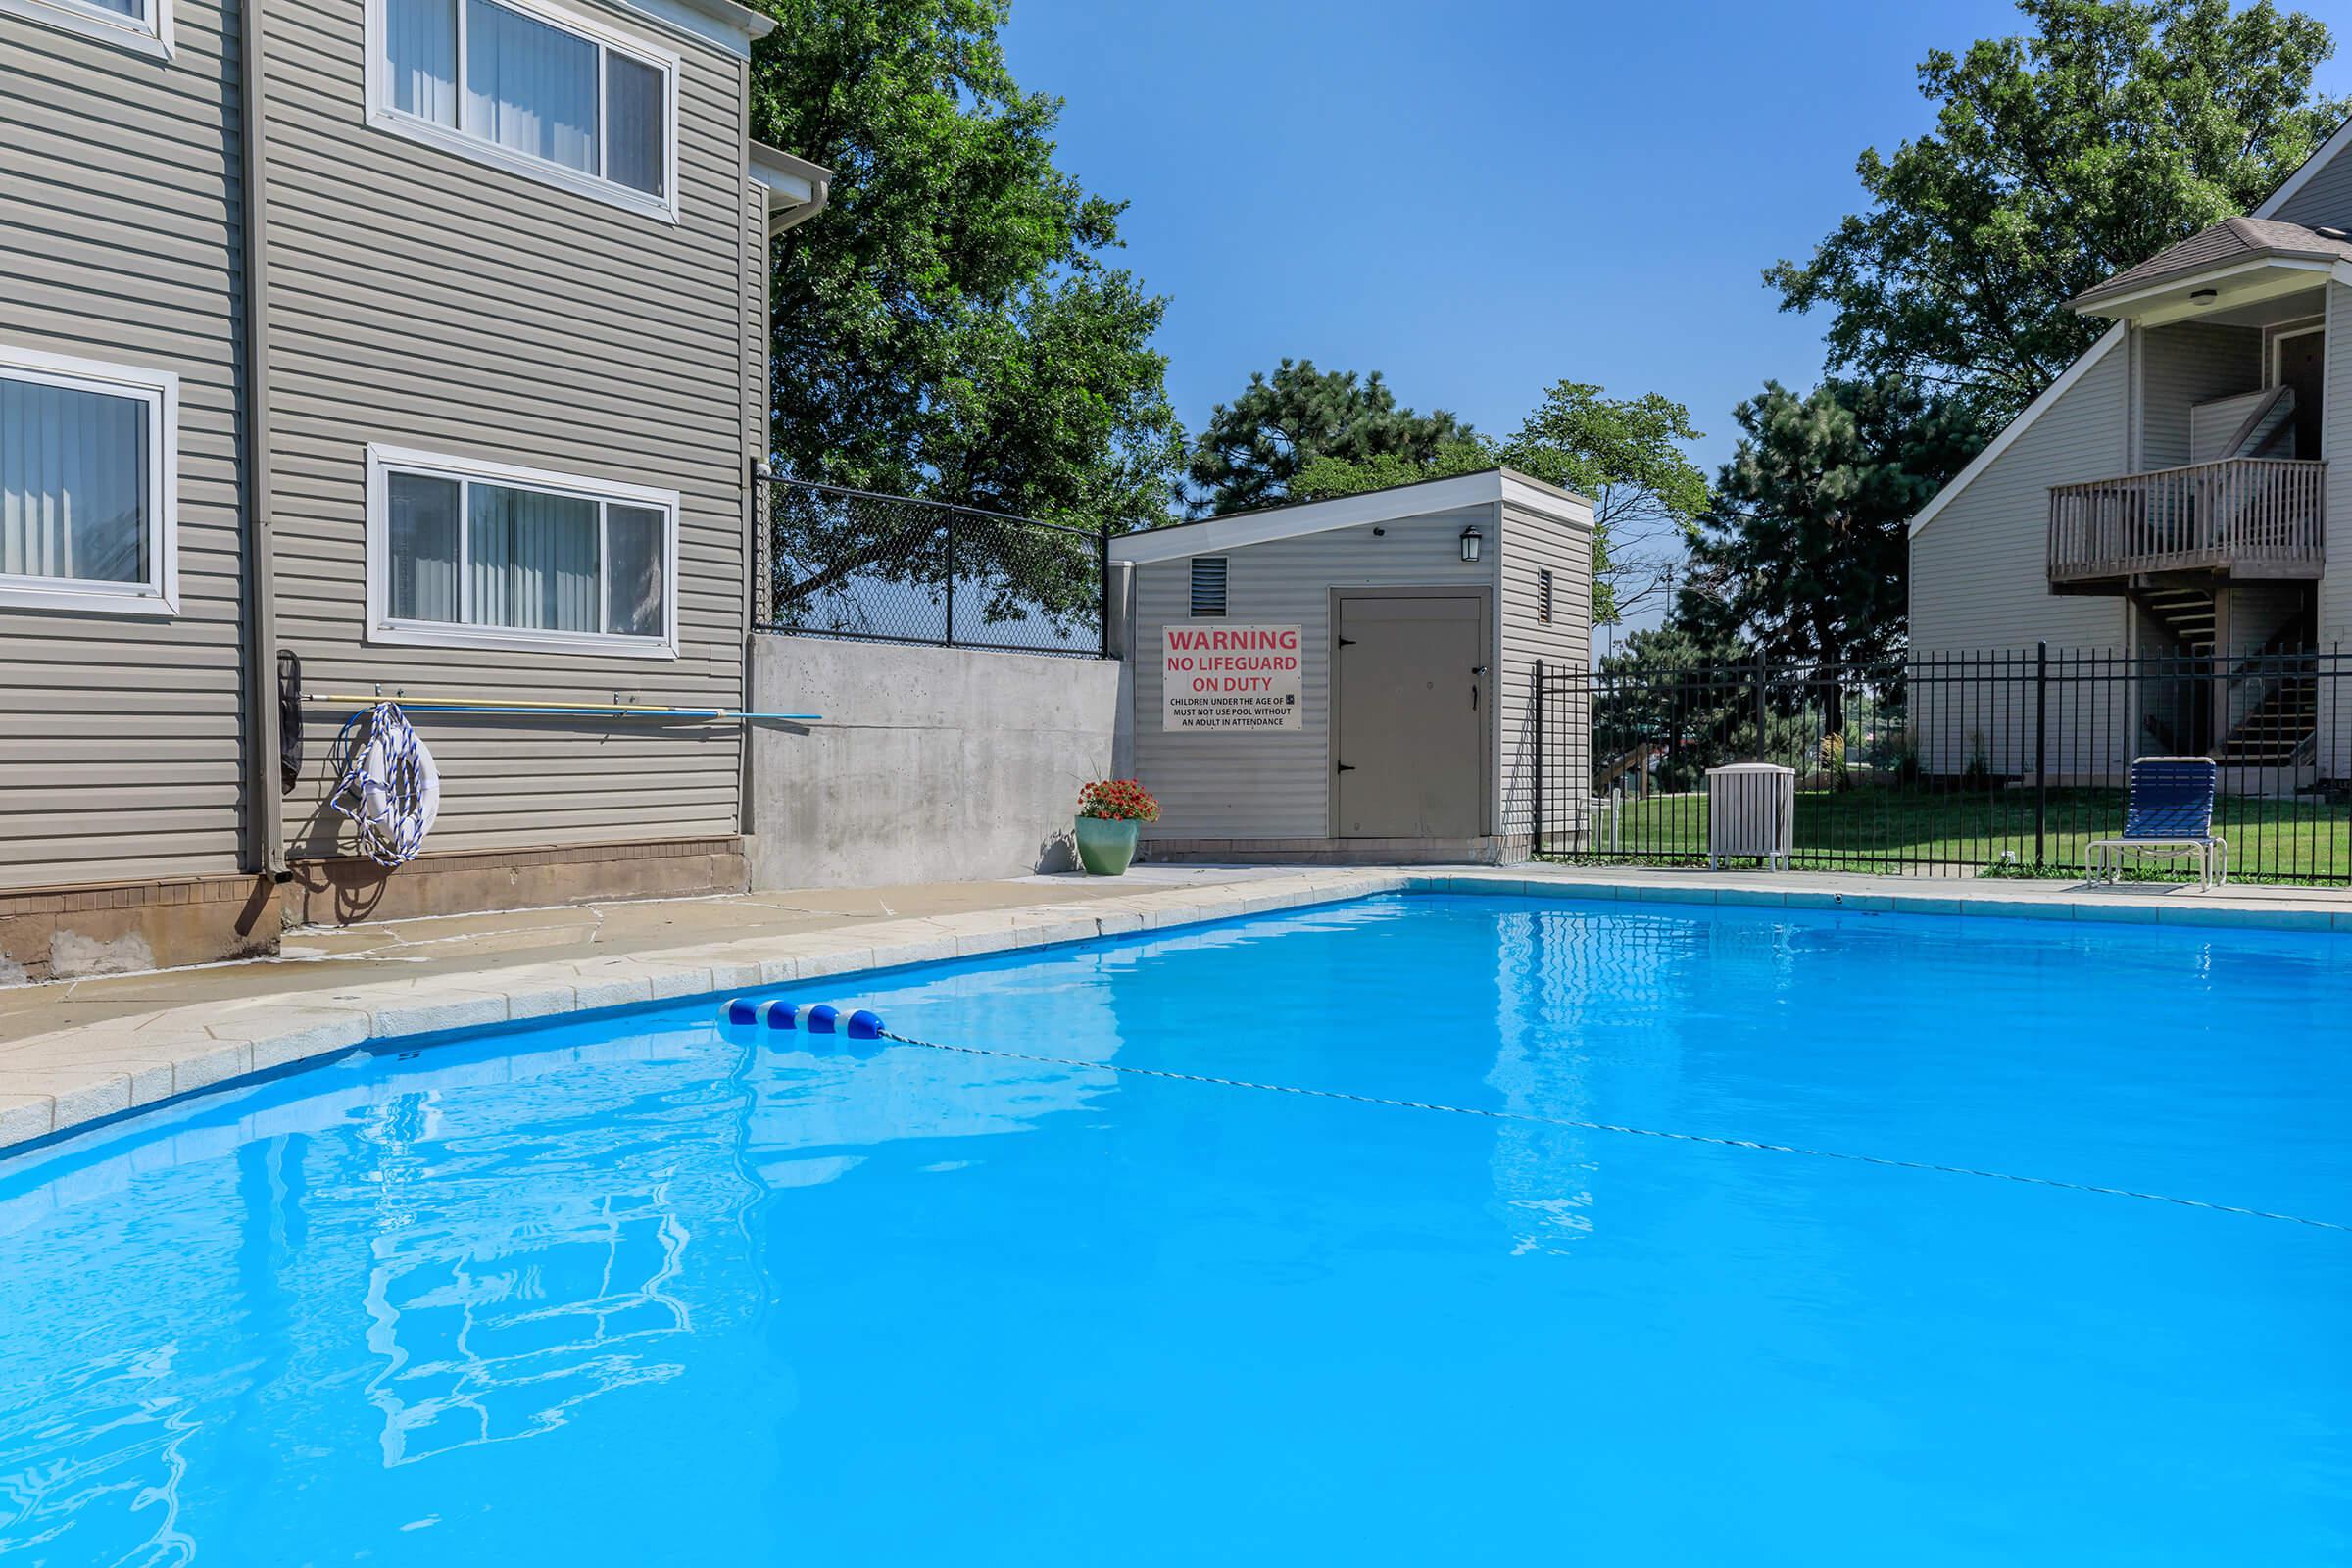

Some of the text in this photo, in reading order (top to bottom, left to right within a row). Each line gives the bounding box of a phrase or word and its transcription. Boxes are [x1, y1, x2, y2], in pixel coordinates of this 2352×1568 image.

[1168, 631, 1297, 650] WARNING
[1167, 657, 1297, 671] NO LIFEGUARD
[1192, 677, 1272, 692] ON DUTY
[1170, 697, 1209, 706] CHILDREN
[1211, 697, 1238, 706] UNDER
[1238, 697, 1254, 706] THE
[1255, 697, 1272, 706] AGE
[1273, 697, 1284, 705] OF
[1174, 708, 1196, 716] MUST
[1197, 708, 1214, 716] NOT
[1254, 708, 1291, 716] WITHOUT
